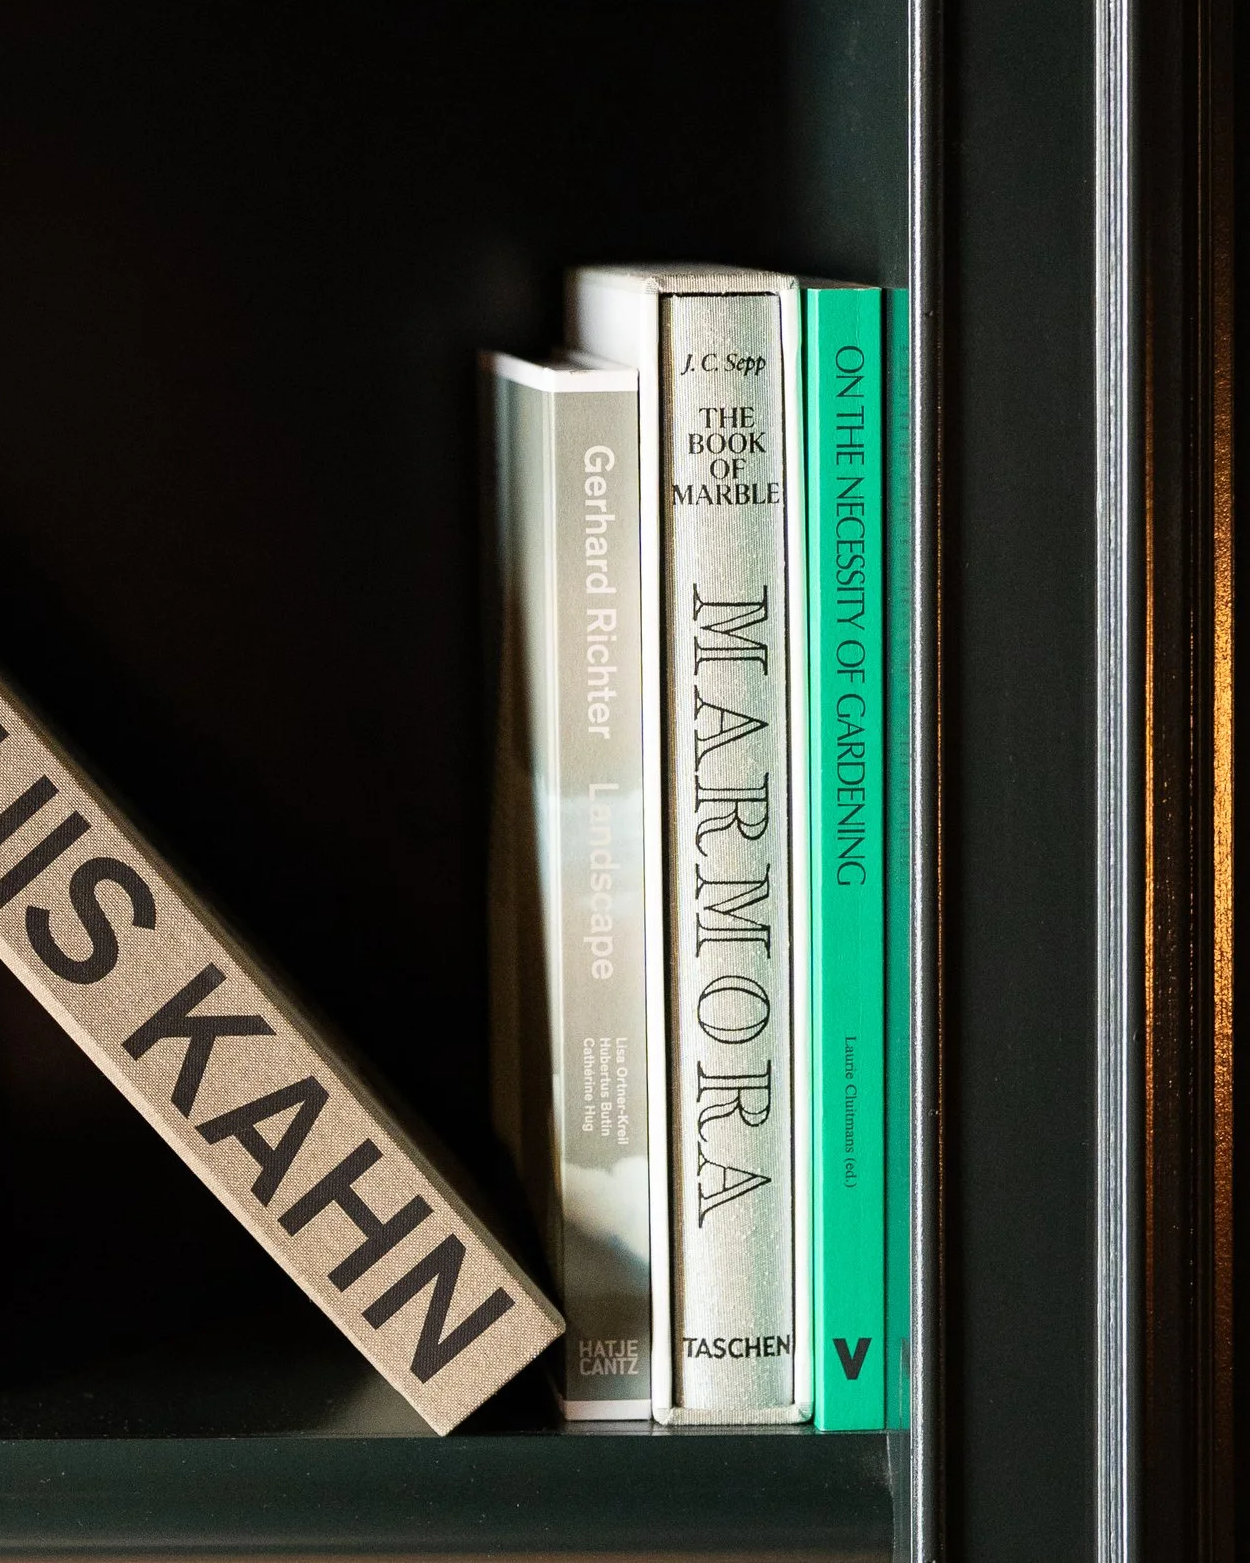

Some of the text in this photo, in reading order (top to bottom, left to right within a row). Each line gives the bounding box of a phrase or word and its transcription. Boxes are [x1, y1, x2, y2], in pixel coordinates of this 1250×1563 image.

[680, 352, 767, 376] J. C. Sepp
[699, 406, 755, 428] THE
[688, 432, 767, 454] BOOK
[709, 459, 745, 480] OF
[671, 482, 781, 506] MARBLE
[835, 345, 867, 887] ON THE NECESSITY OF GARDENING
[583, 445, 620, 981] Gerhard Richter Landscape
[693, 583, 772, 1229] MARMORA
[599, 1037, 613, 1136] Hubertus Butin
[616, 1037, 630, 1145] Lisa Ortner-Kreil
[582, 1105, 596, 1132] Hug
[843, 1036, 858, 1189] Laurie Cluitmans (ed.)
[120, 961, 518, 1386] KAHN
[579, 1340, 638, 1357] HATJE
[683, 1334, 792, 1359] TASCHEN
[579, 1356, 639, 1376] CANTZ
